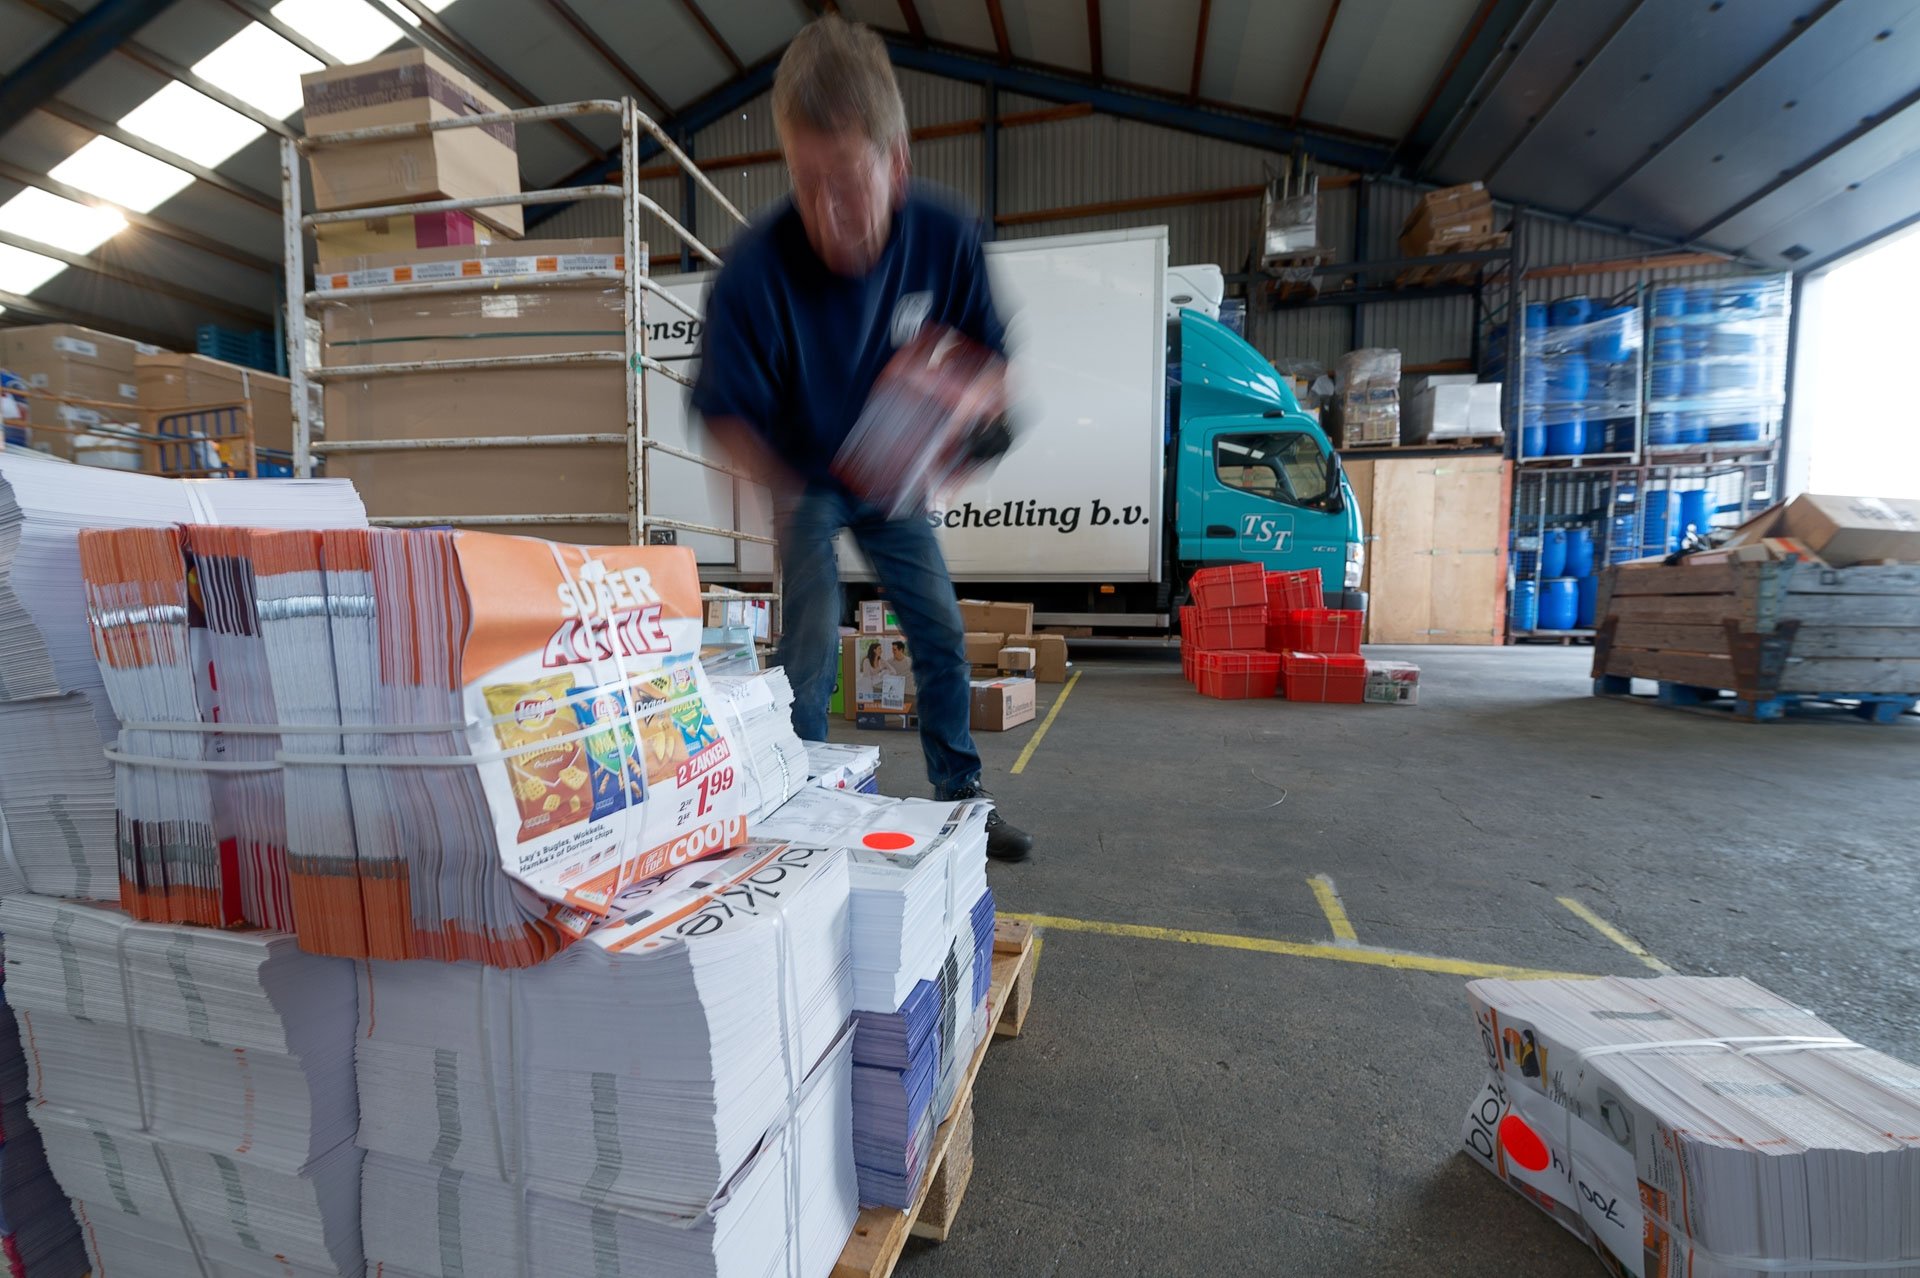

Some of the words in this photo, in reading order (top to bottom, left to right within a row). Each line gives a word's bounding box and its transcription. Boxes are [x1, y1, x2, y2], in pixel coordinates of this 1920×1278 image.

[1090, 499, 1150, 526] b.v.
[1243, 514, 1291, 551] TST
[543, 603, 672, 668] ACTIE
[678, 765, 687, 784] 2
[689, 739, 729, 778] ZAKKEN
[697, 766, 734, 817] 1.99
[556, 849, 565, 858] of
[566, 837, 593, 854] Doritos
[595, 828, 613, 841] chips
[669, 814, 740, 866] coop
